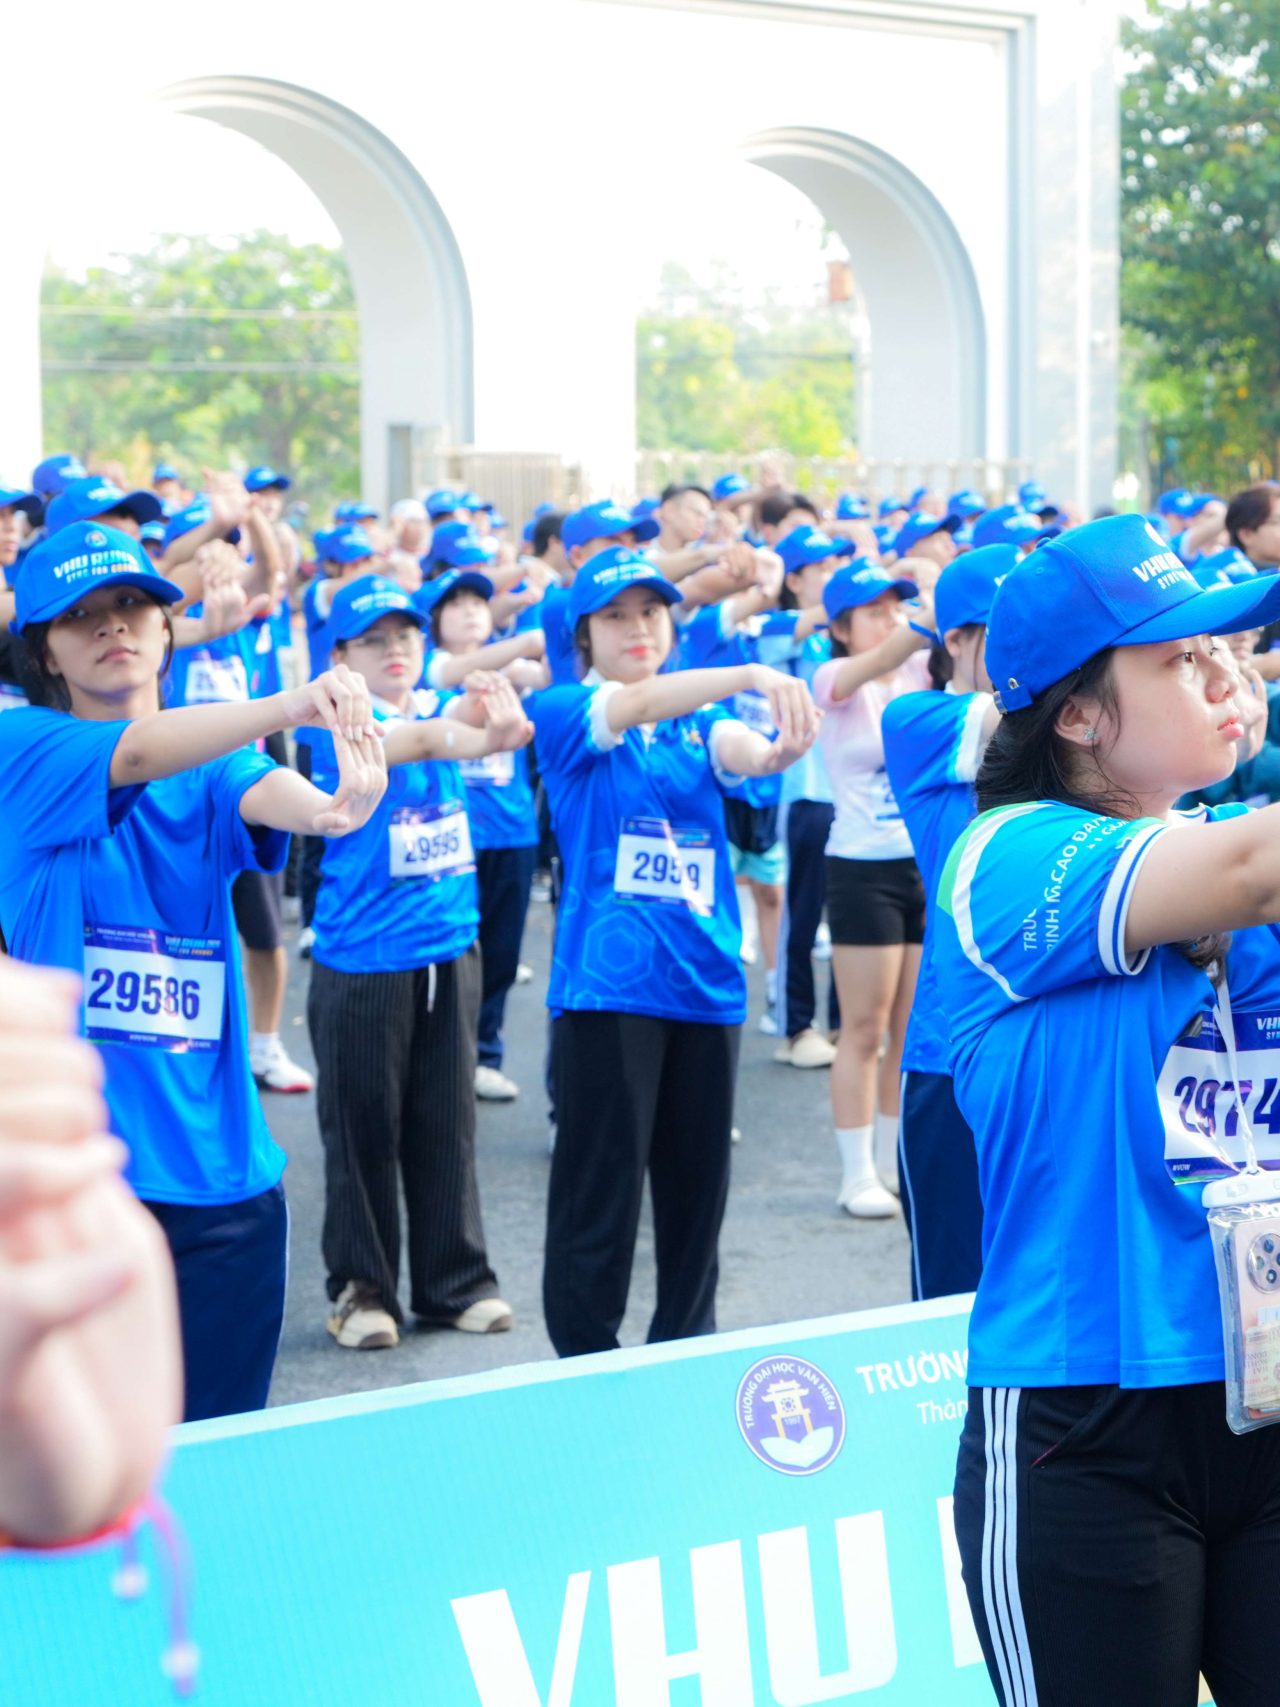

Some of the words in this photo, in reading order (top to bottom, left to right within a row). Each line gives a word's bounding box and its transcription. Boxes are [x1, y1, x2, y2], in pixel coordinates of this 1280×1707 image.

[632, 851, 700, 891] 2959
[88, 967, 200, 1021] 29586
[915, 1398, 968, 1425] Thàn
[450, 1509, 899, 1707] VHU
